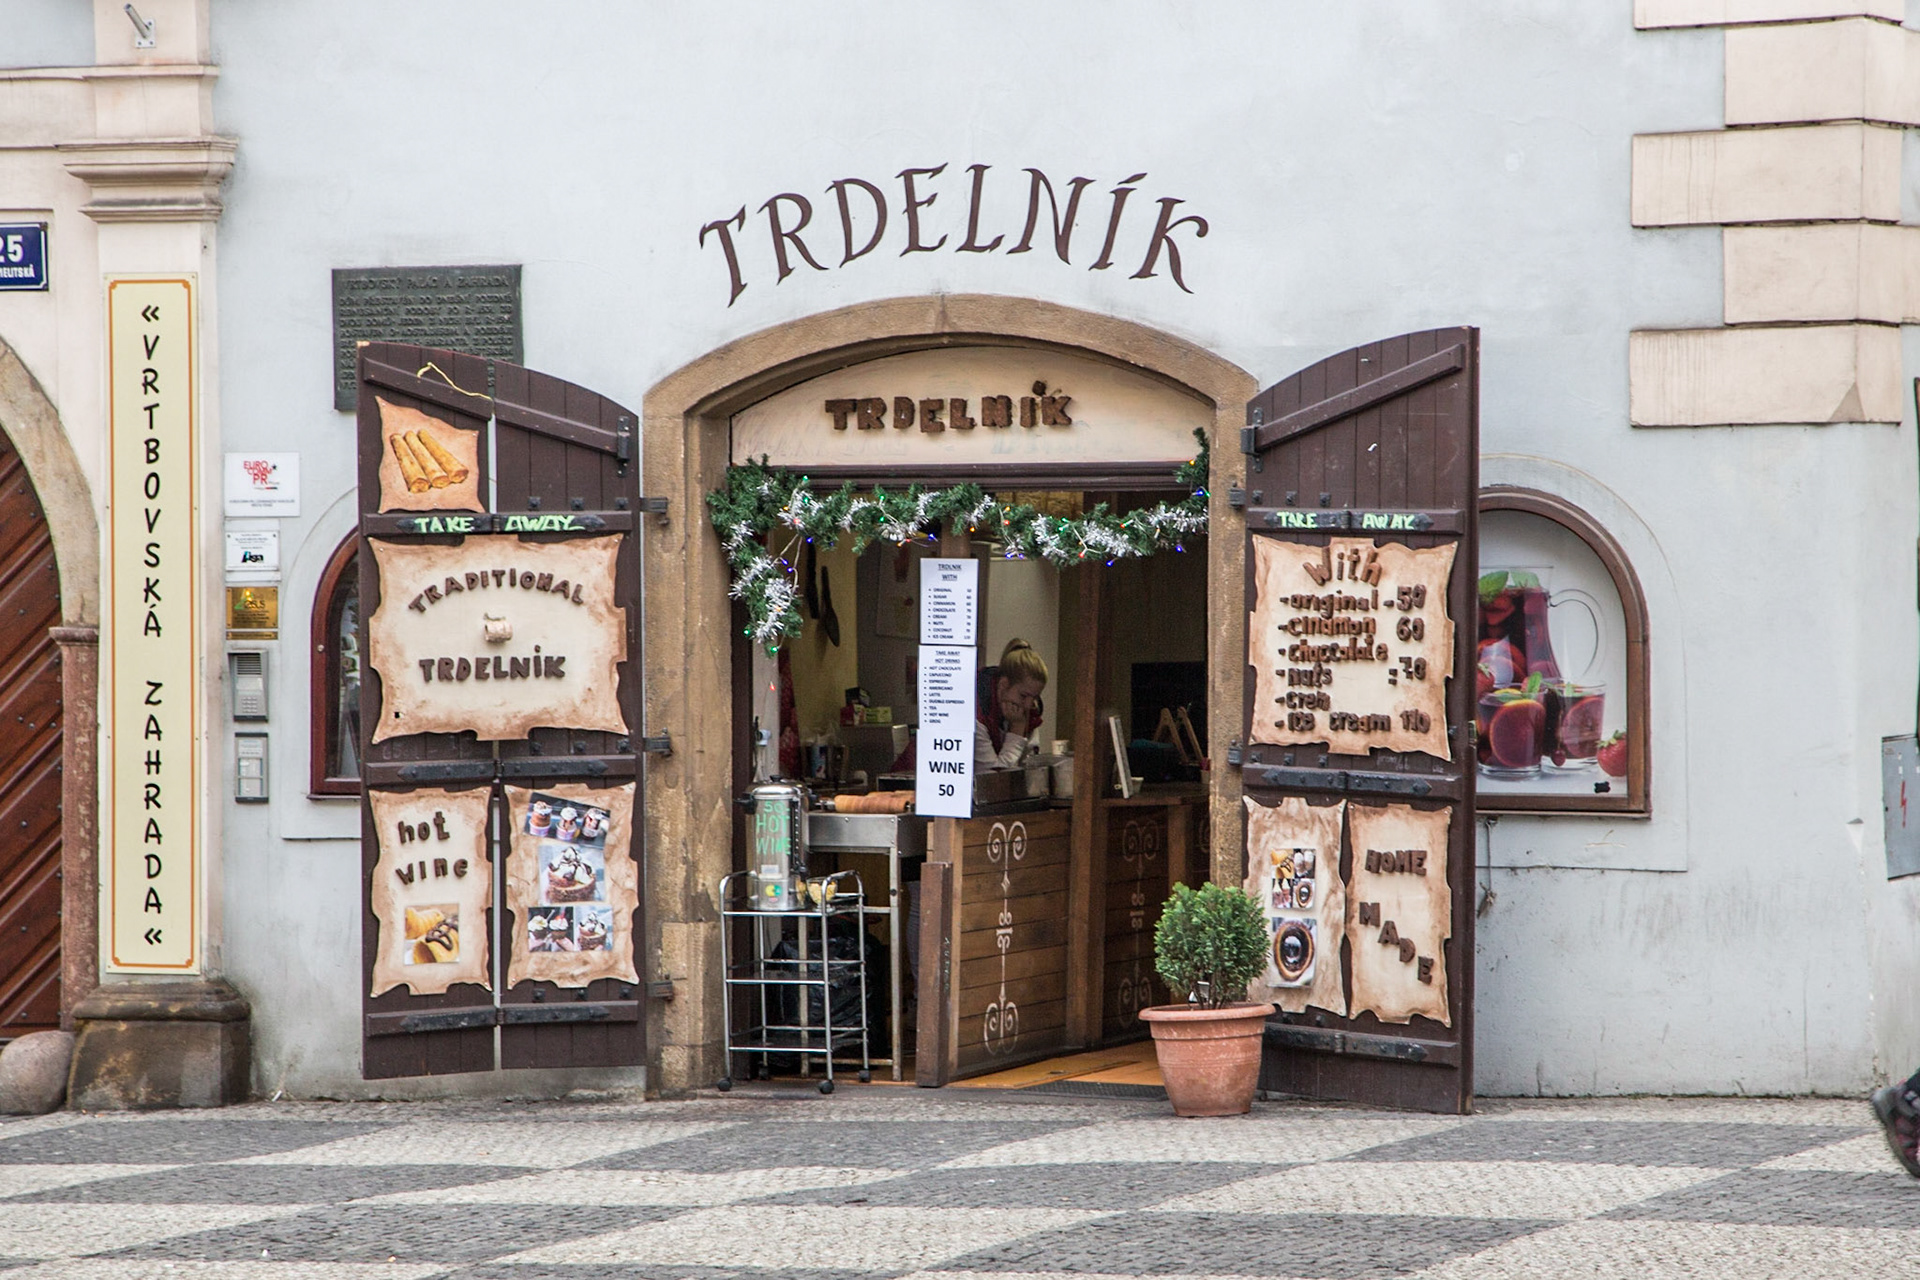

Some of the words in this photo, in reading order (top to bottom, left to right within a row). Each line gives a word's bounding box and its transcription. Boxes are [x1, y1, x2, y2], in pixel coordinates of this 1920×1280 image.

[699, 163, 1208, 308] TRDELNÍK
[142, 334, 162, 637] VRTBOVSKÁ
[414, 516, 475, 534] TAKE
[505, 515, 585, 532] AWAY
[1276, 511, 1318, 529] TAKE
[1362, 512, 1416, 531] AWAY
[408, 568, 584, 613] TRADITIONAL
[1396, 616, 1425, 641] 60
[933, 738, 963, 751] HOT
[928, 760, 966, 775] WINE
[144, 680, 163, 914] ZAHRADA
[938, 783, 955, 797] 50
[398, 811, 450, 845] hot
[756, 813, 790, 834] HOT
[1365, 849, 1428, 876] HOME
[1358, 901, 1434, 985] MADE
